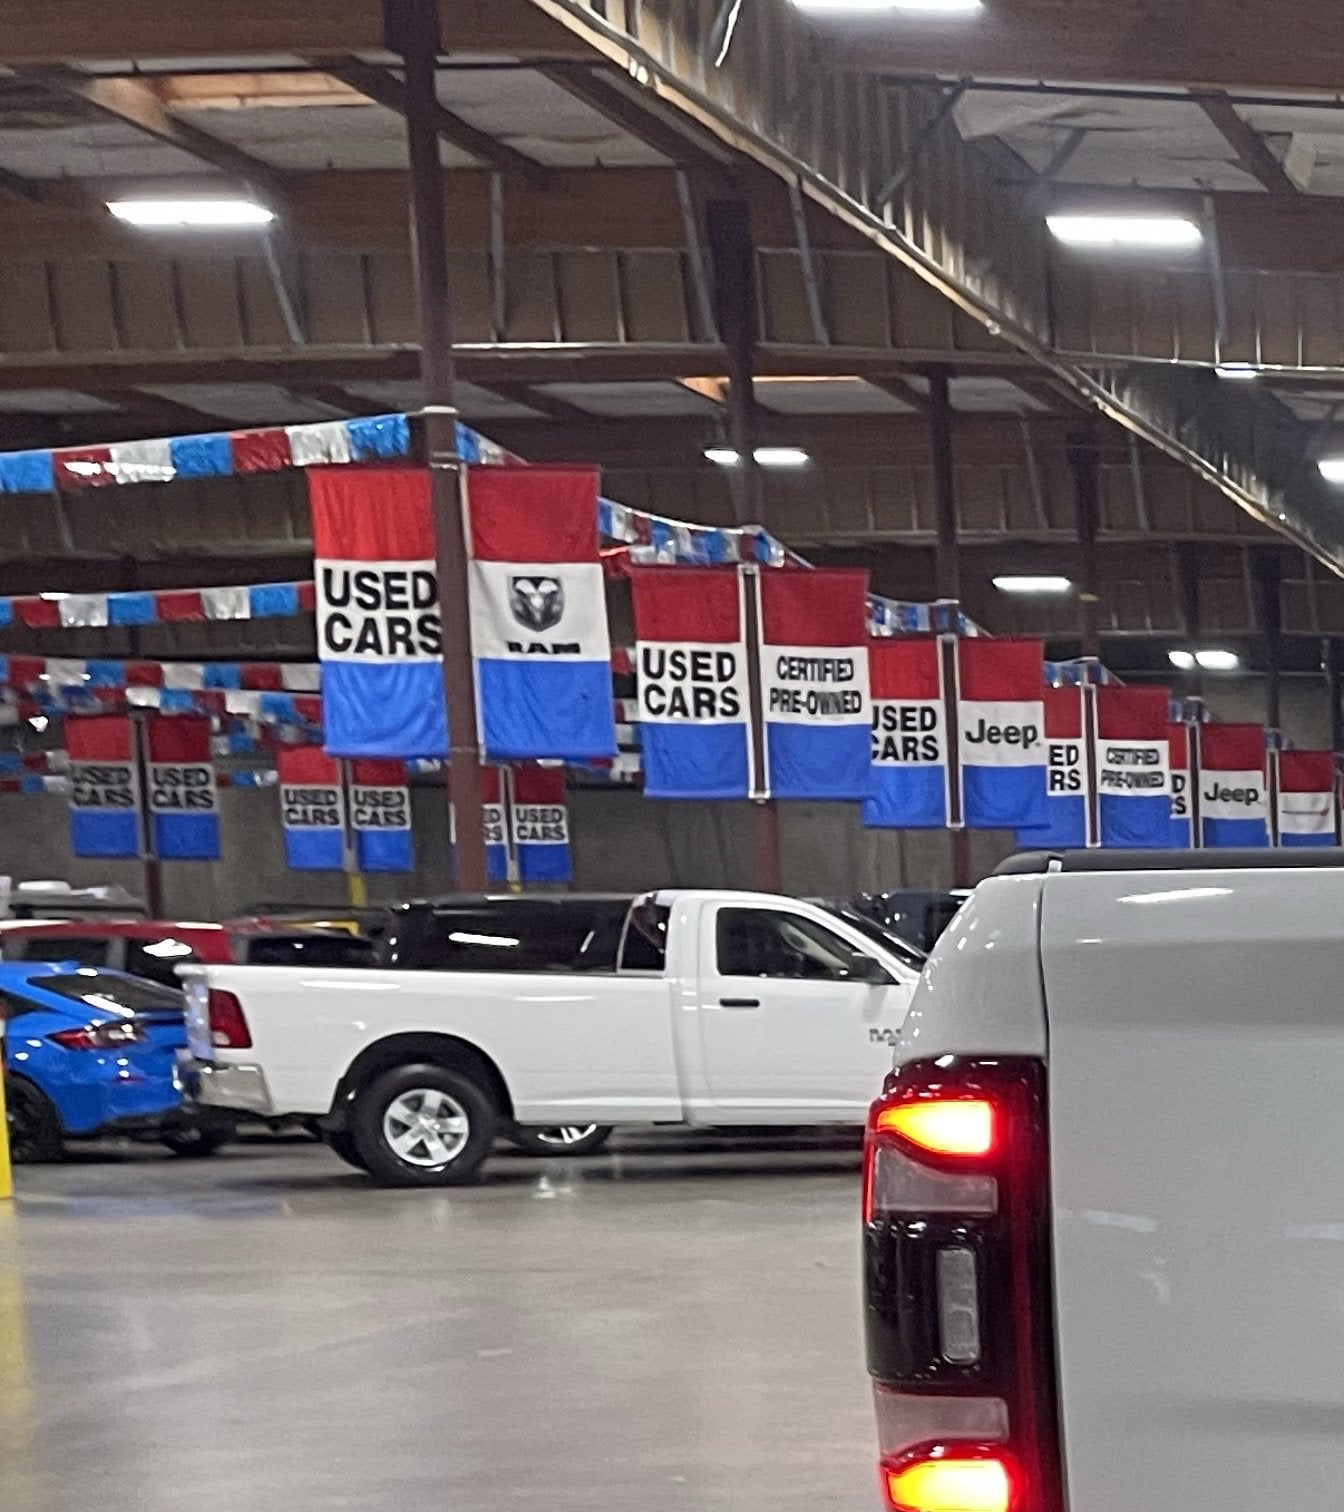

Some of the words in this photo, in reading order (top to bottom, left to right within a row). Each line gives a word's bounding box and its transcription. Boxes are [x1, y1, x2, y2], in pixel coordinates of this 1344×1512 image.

[323, 568, 438, 610] USED
[325, 612, 442, 656] CARS
[642, 648, 736, 682] USED
[776, 656, 855, 682] CERTIFIED
[644, 684, 740, 718] CARS
[769, 687, 862, 714] PRE-OWNED
[965, 718, 1039, 749] Jeep
[871, 734, 939, 762] ARS
[152, 767, 210, 787] USED
[152, 789, 214, 808] CARS
[285, 789, 338, 806] USED
[354, 790, 405, 808] USED
[1203, 782, 1259, 806] Jeep
[286, 808, 340, 826] CARS
[355, 808, 407, 827] CARS
[516, 808, 563, 823] USED
[517, 825, 566, 841] CARS
